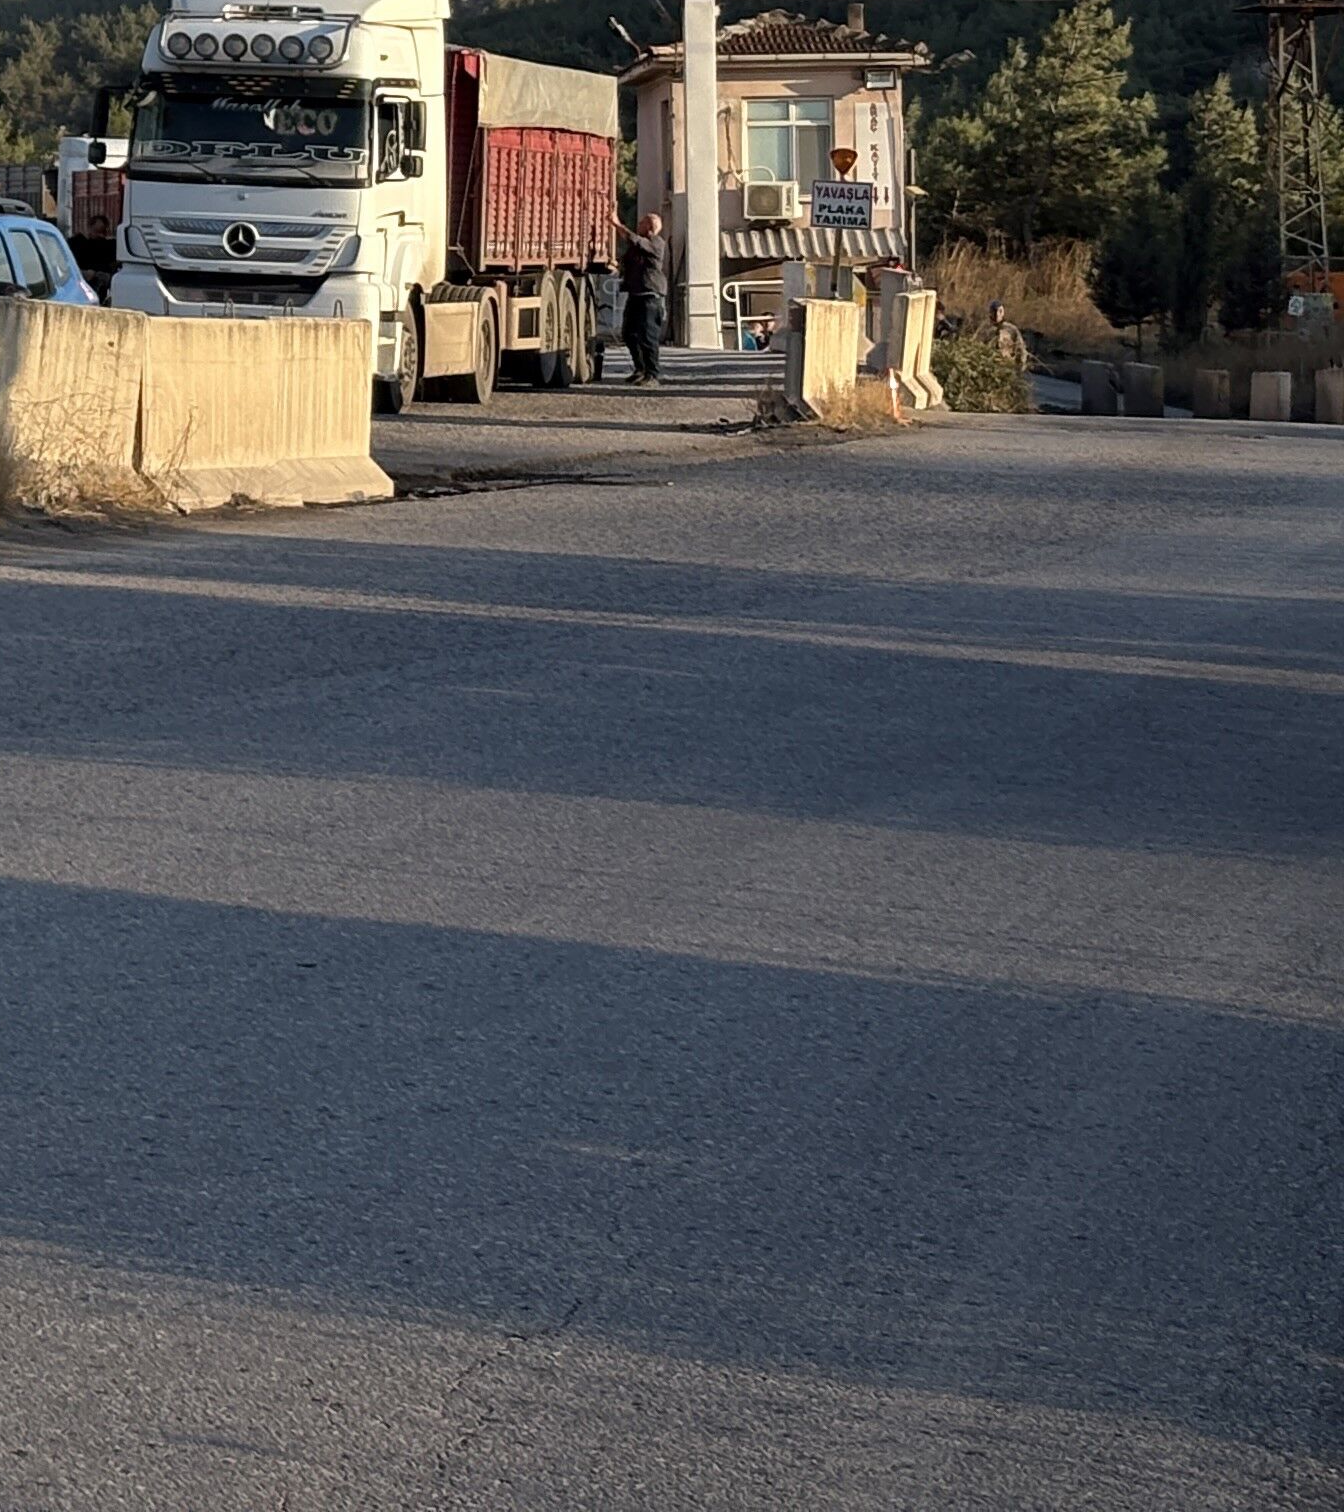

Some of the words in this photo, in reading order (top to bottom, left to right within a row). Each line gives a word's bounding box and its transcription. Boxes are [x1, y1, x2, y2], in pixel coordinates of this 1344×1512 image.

[815, 185, 870, 203] YAVAŞLA
[818, 203, 866, 216] PLAKA
[814, 214, 868, 227] TANIMA
